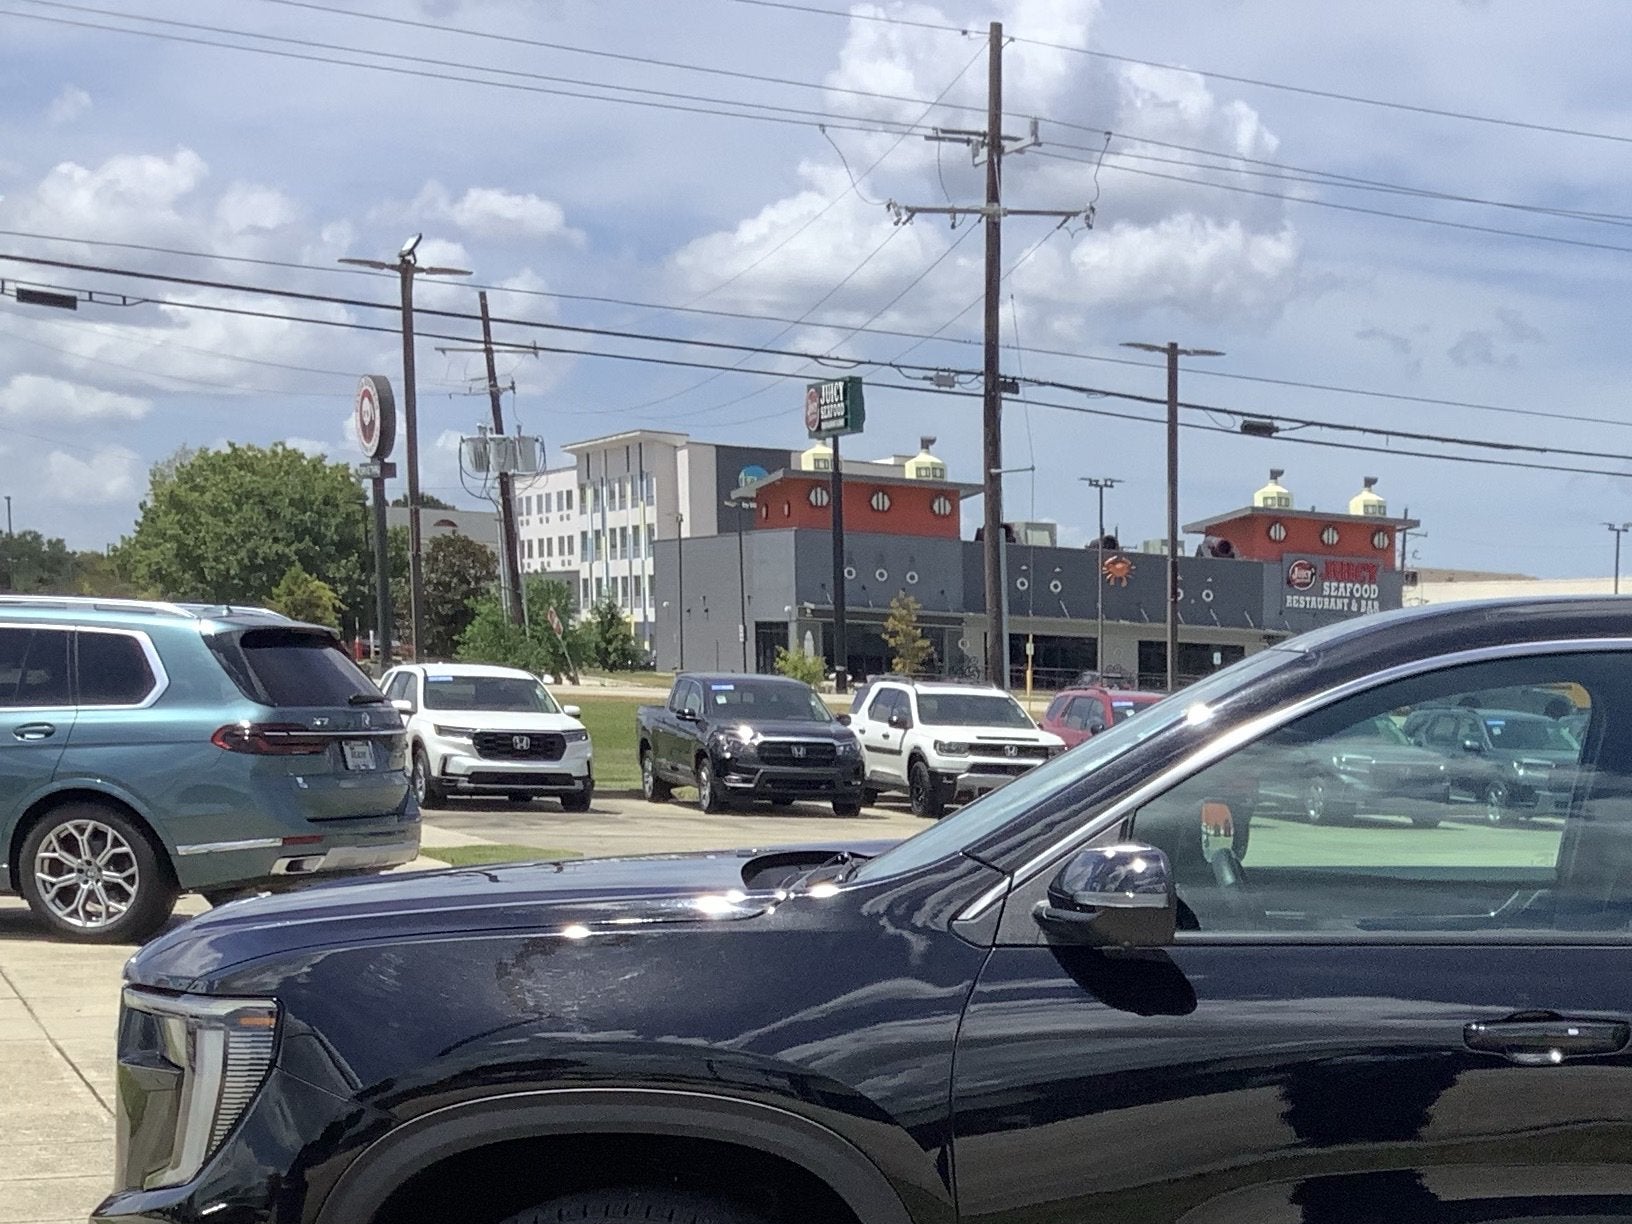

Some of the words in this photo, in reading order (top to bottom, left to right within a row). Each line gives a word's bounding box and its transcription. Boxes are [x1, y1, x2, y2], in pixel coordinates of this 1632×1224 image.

[820, 381, 844, 405] JUICY
[1322, 581, 1379, 599] SEAFOOD
[1285, 595, 1349, 611] RESTAURANT
[1350, 599, 1358, 612] &
[1360, 599, 1380, 615] BAR
